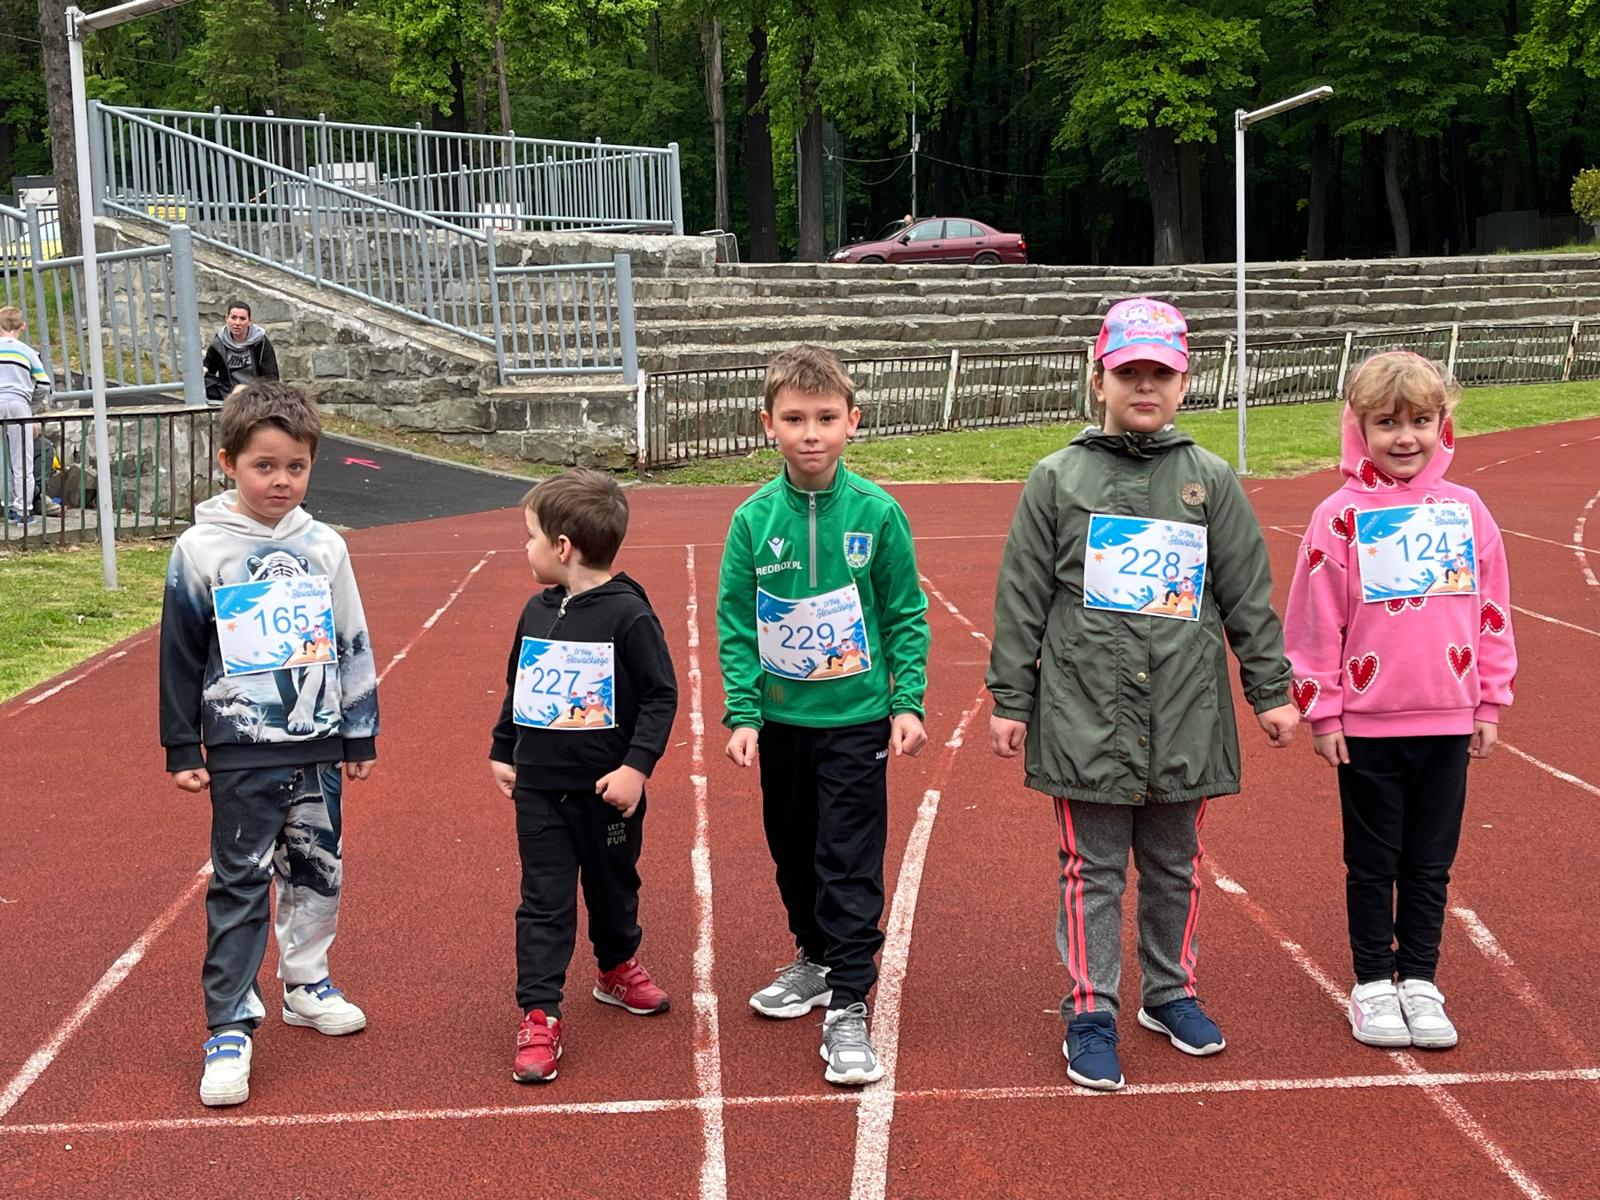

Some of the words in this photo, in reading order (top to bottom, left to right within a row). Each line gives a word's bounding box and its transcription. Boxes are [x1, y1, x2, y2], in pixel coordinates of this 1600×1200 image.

[1396, 531, 1451, 562] 124
[755, 560, 803, 577] REDBOX.PL
[1118, 546, 1180, 579] 228
[254, 605, 309, 637] 165
[779, 622, 835, 650] 229
[531, 666, 581, 700] 227
[875, 748, 888, 760] JAK
[607, 833, 627, 847] FUN
